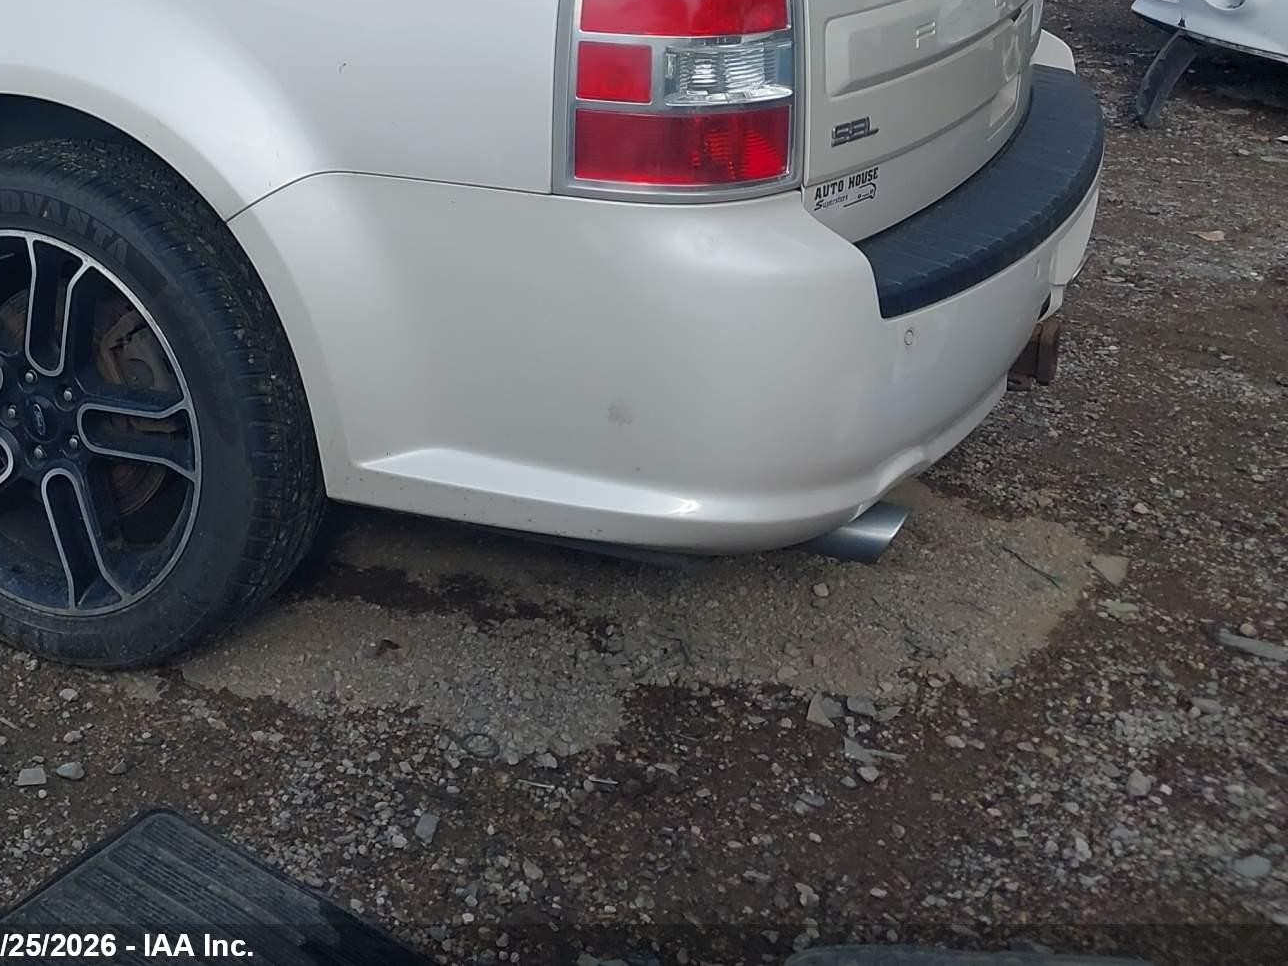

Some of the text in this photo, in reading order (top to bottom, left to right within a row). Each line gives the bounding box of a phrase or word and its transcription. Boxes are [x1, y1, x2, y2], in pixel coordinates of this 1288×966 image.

[831, 116, 880, 147] SEL
[814, 167, 879, 201] AUTO HOUSE
